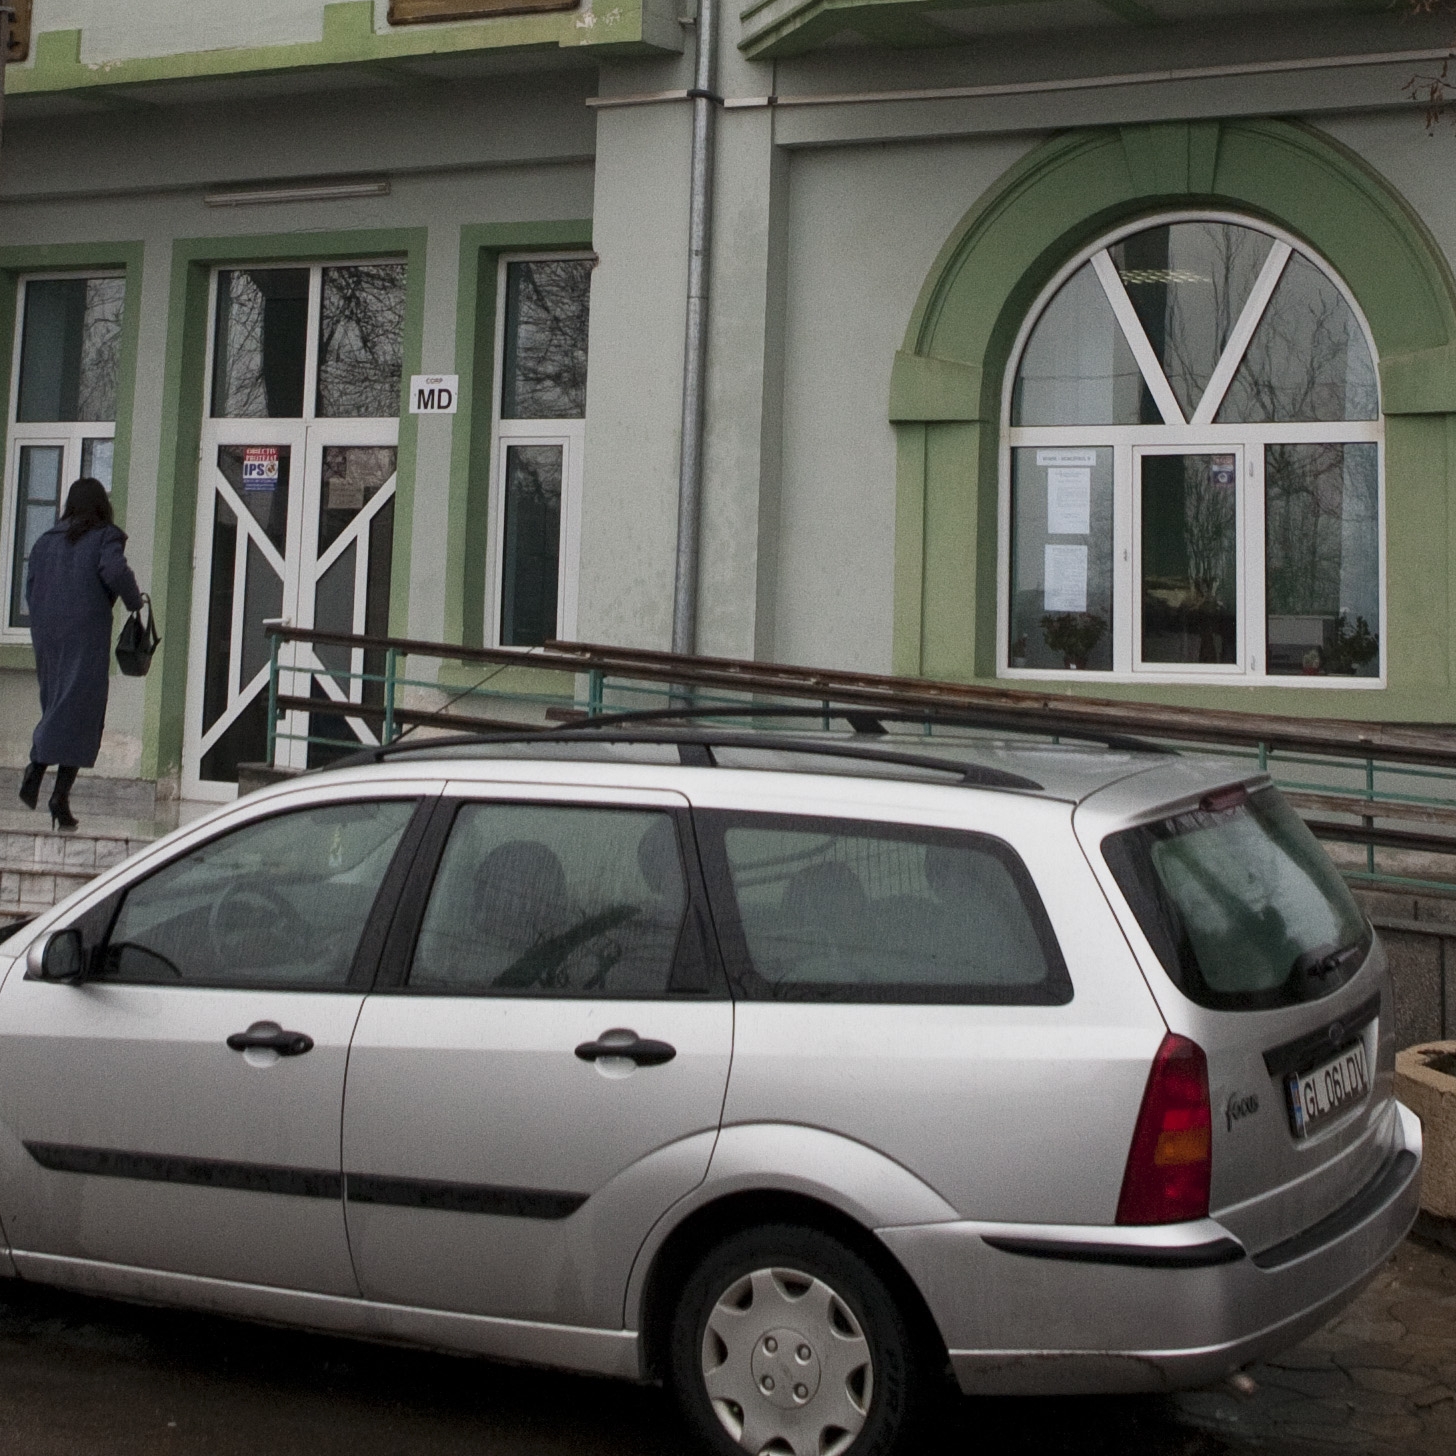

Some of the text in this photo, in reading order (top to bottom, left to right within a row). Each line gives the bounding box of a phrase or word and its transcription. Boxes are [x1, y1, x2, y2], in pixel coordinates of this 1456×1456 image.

[425, 377, 443, 385] CORP
[417, 388, 452, 410] MD
[244, 463, 265, 476] IPS
[1304, 1077, 1325, 1120] GL
